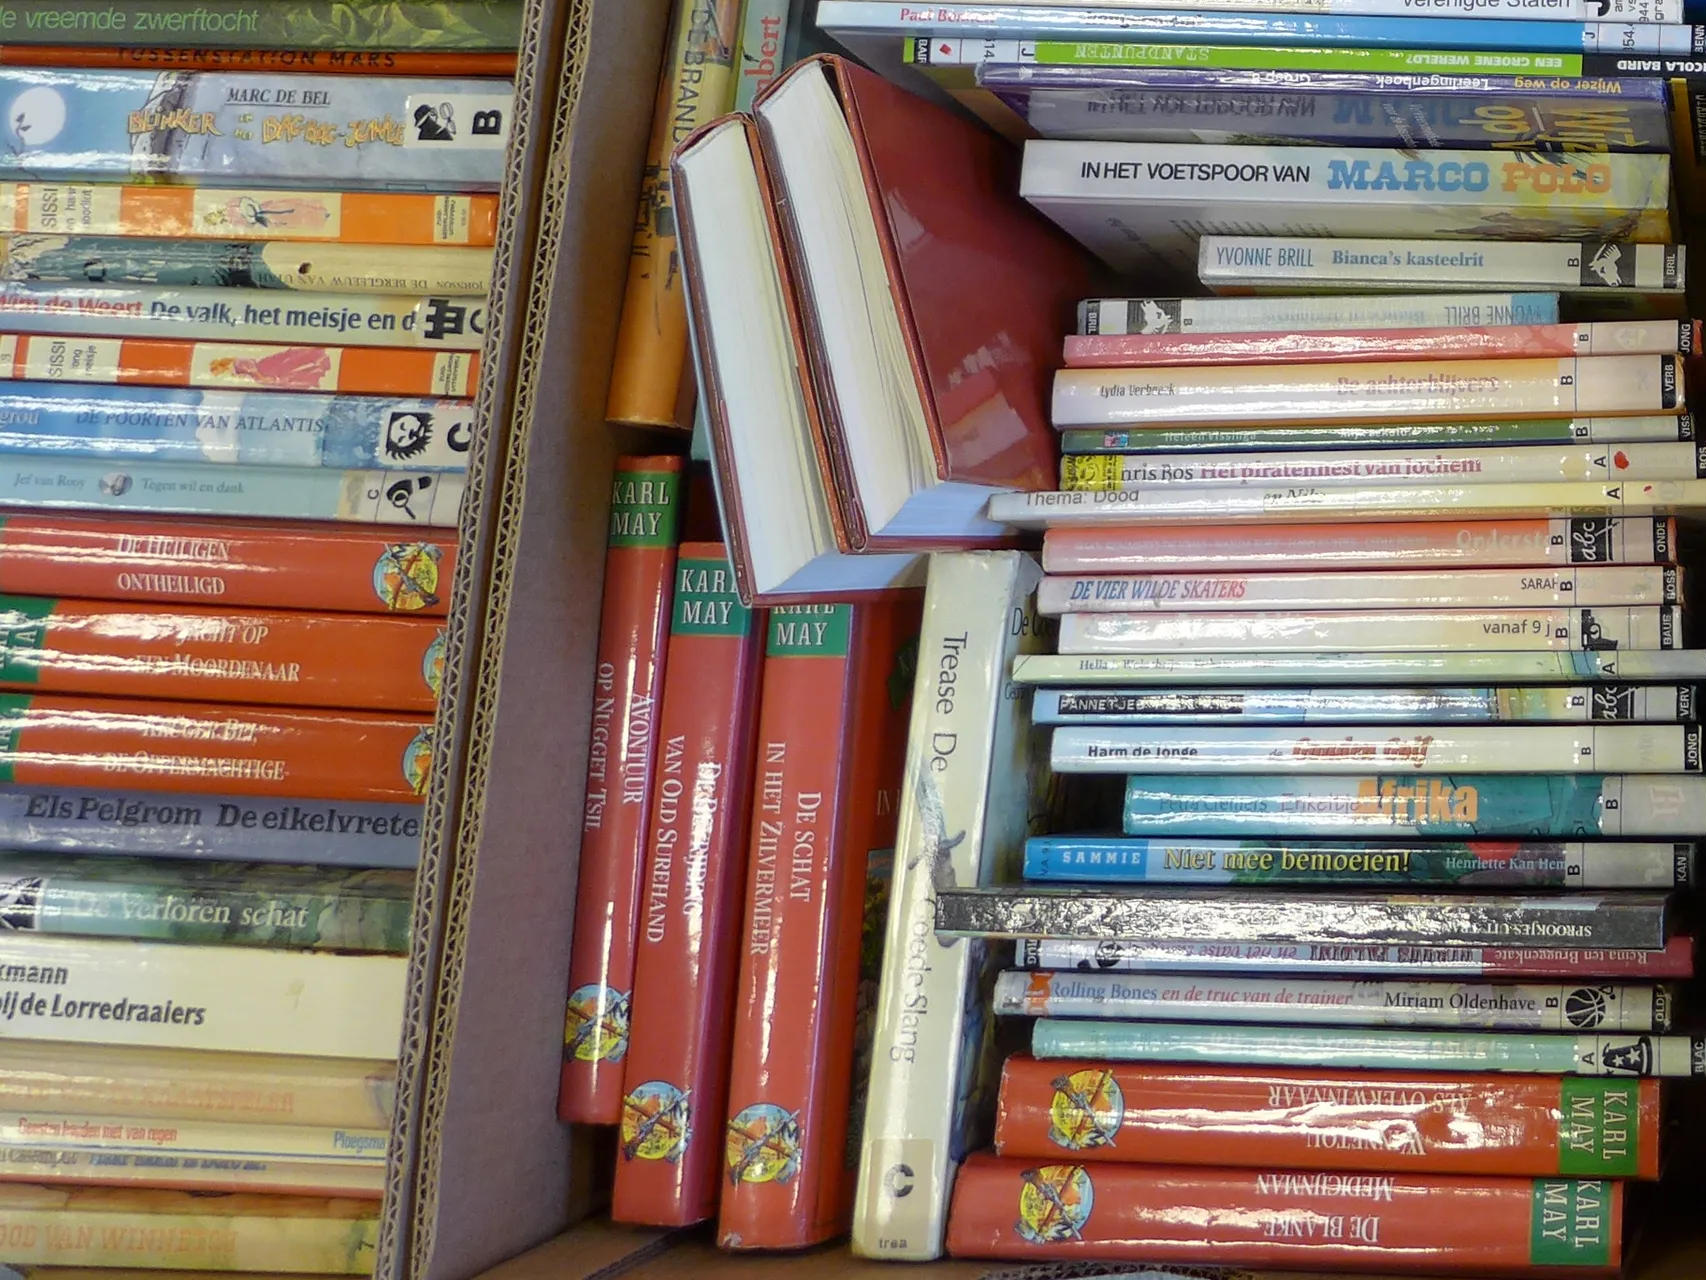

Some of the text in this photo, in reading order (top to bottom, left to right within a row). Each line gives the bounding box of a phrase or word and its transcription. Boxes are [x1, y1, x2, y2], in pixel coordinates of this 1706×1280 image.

[24, 5, 260, 33] vreemde zwerftocht
[1617, 58, 1662, 71] BAIRD
[226, 88, 272, 103] MARC
[1146, 158, 1612, 194] VOETSPOOR MARCO POLO
[1216, 247, 1484, 270] YVONNE BRILL Bianca's kasteelrit
[1664, 252, 1677, 276] BRIL
[244, 304, 362, 332] het meisje
[610, 479, 671, 508] KARL
[611, 509, 663, 538] MAY
[117, 572, 226, 595] ONTHEILIGD
[1132, 580, 1248, 600] WILDE SKATERS
[681, 598, 734, 625] MAY
[774, 619, 830, 648] MAY
[1482, 619, 1529, 635] vanaf
[172, 654, 300, 682] MOORDENAAR
[935, 630, 969, 716] Trease
[25, 794, 260, 830] Els Pelgrom De
[790, 792, 821, 902] DE SCHAT
[1061, 846, 1412, 875] SAMMIE Niet mee bemoeien!
[751, 772, 784, 956] HET ZILVERMEER
[647, 828, 678, 943] SUREHAND
[240, 900, 308, 929] schat
[50, 994, 207, 1026] Lorredraaiers
[1384, 990, 1536, 1011] Miriam Oldenhave
[1571, 1096, 1594, 1154] MAY
[1602, 1090, 1628, 1161] KARL
